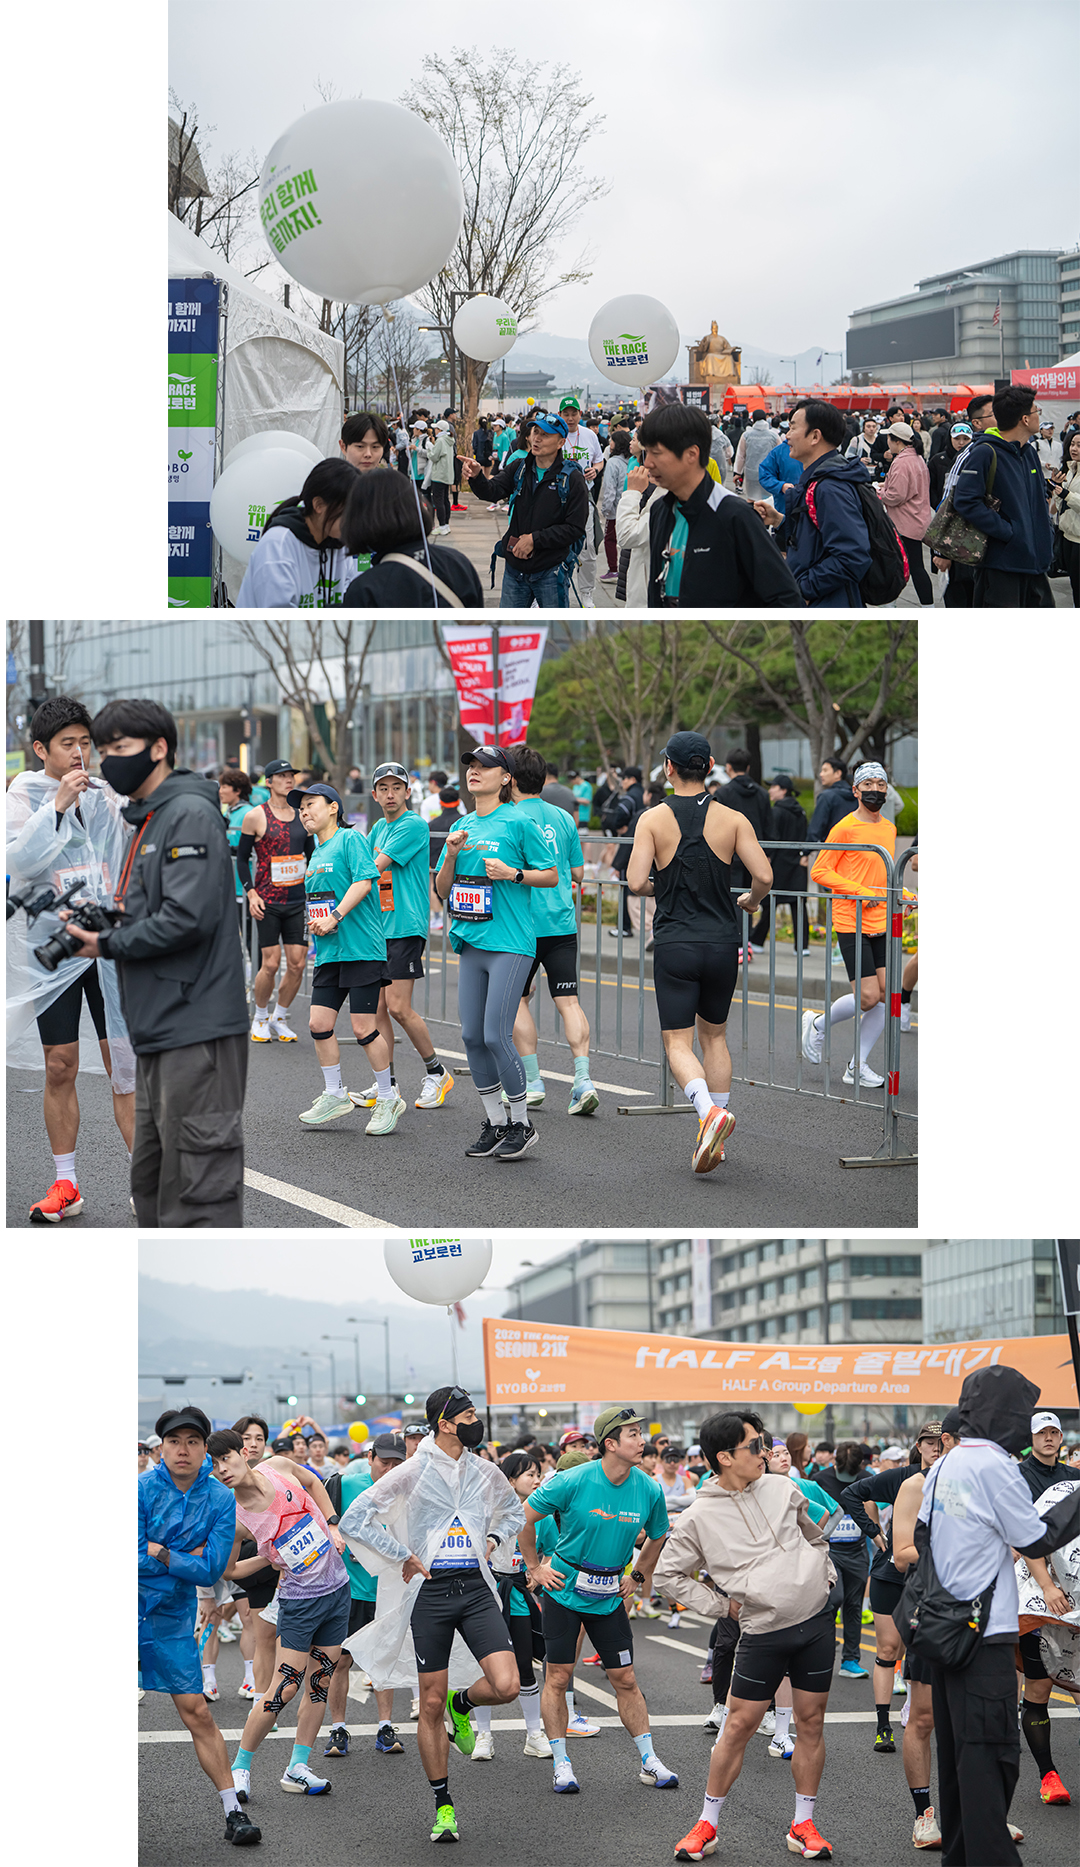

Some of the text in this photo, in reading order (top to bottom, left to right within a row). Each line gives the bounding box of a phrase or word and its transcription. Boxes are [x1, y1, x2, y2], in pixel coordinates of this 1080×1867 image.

[276, 168, 318, 209] 함께
[269, 201, 322, 254] 끝까지!
[175, 302, 202, 316] 함께
[603, 341, 648, 356] THE RACE
[606, 354, 649, 366] 교보로런
[1031, 371, 1076, 389] 여자탈의실
[168, 384, 197, 396] RACE
[248, 504, 267, 513] 2026
[168, 525, 195, 540] 함께
[280, 865, 299, 875] 1155
[455, 891, 481, 904] 41780
[411, 1244, 463, 1263] 교보로런
[523, 1331, 543, 1341] THE
[495, 1341, 568, 1358] SEOUL 21K
[635, 1346, 1004, 1377] HALF A그룹 출발대기
[496, 1382, 538, 1394] KYOBO
[722, 1379, 910, 1395] HALF A Group Departure Area
[289, 1530, 315, 1556] 3247
